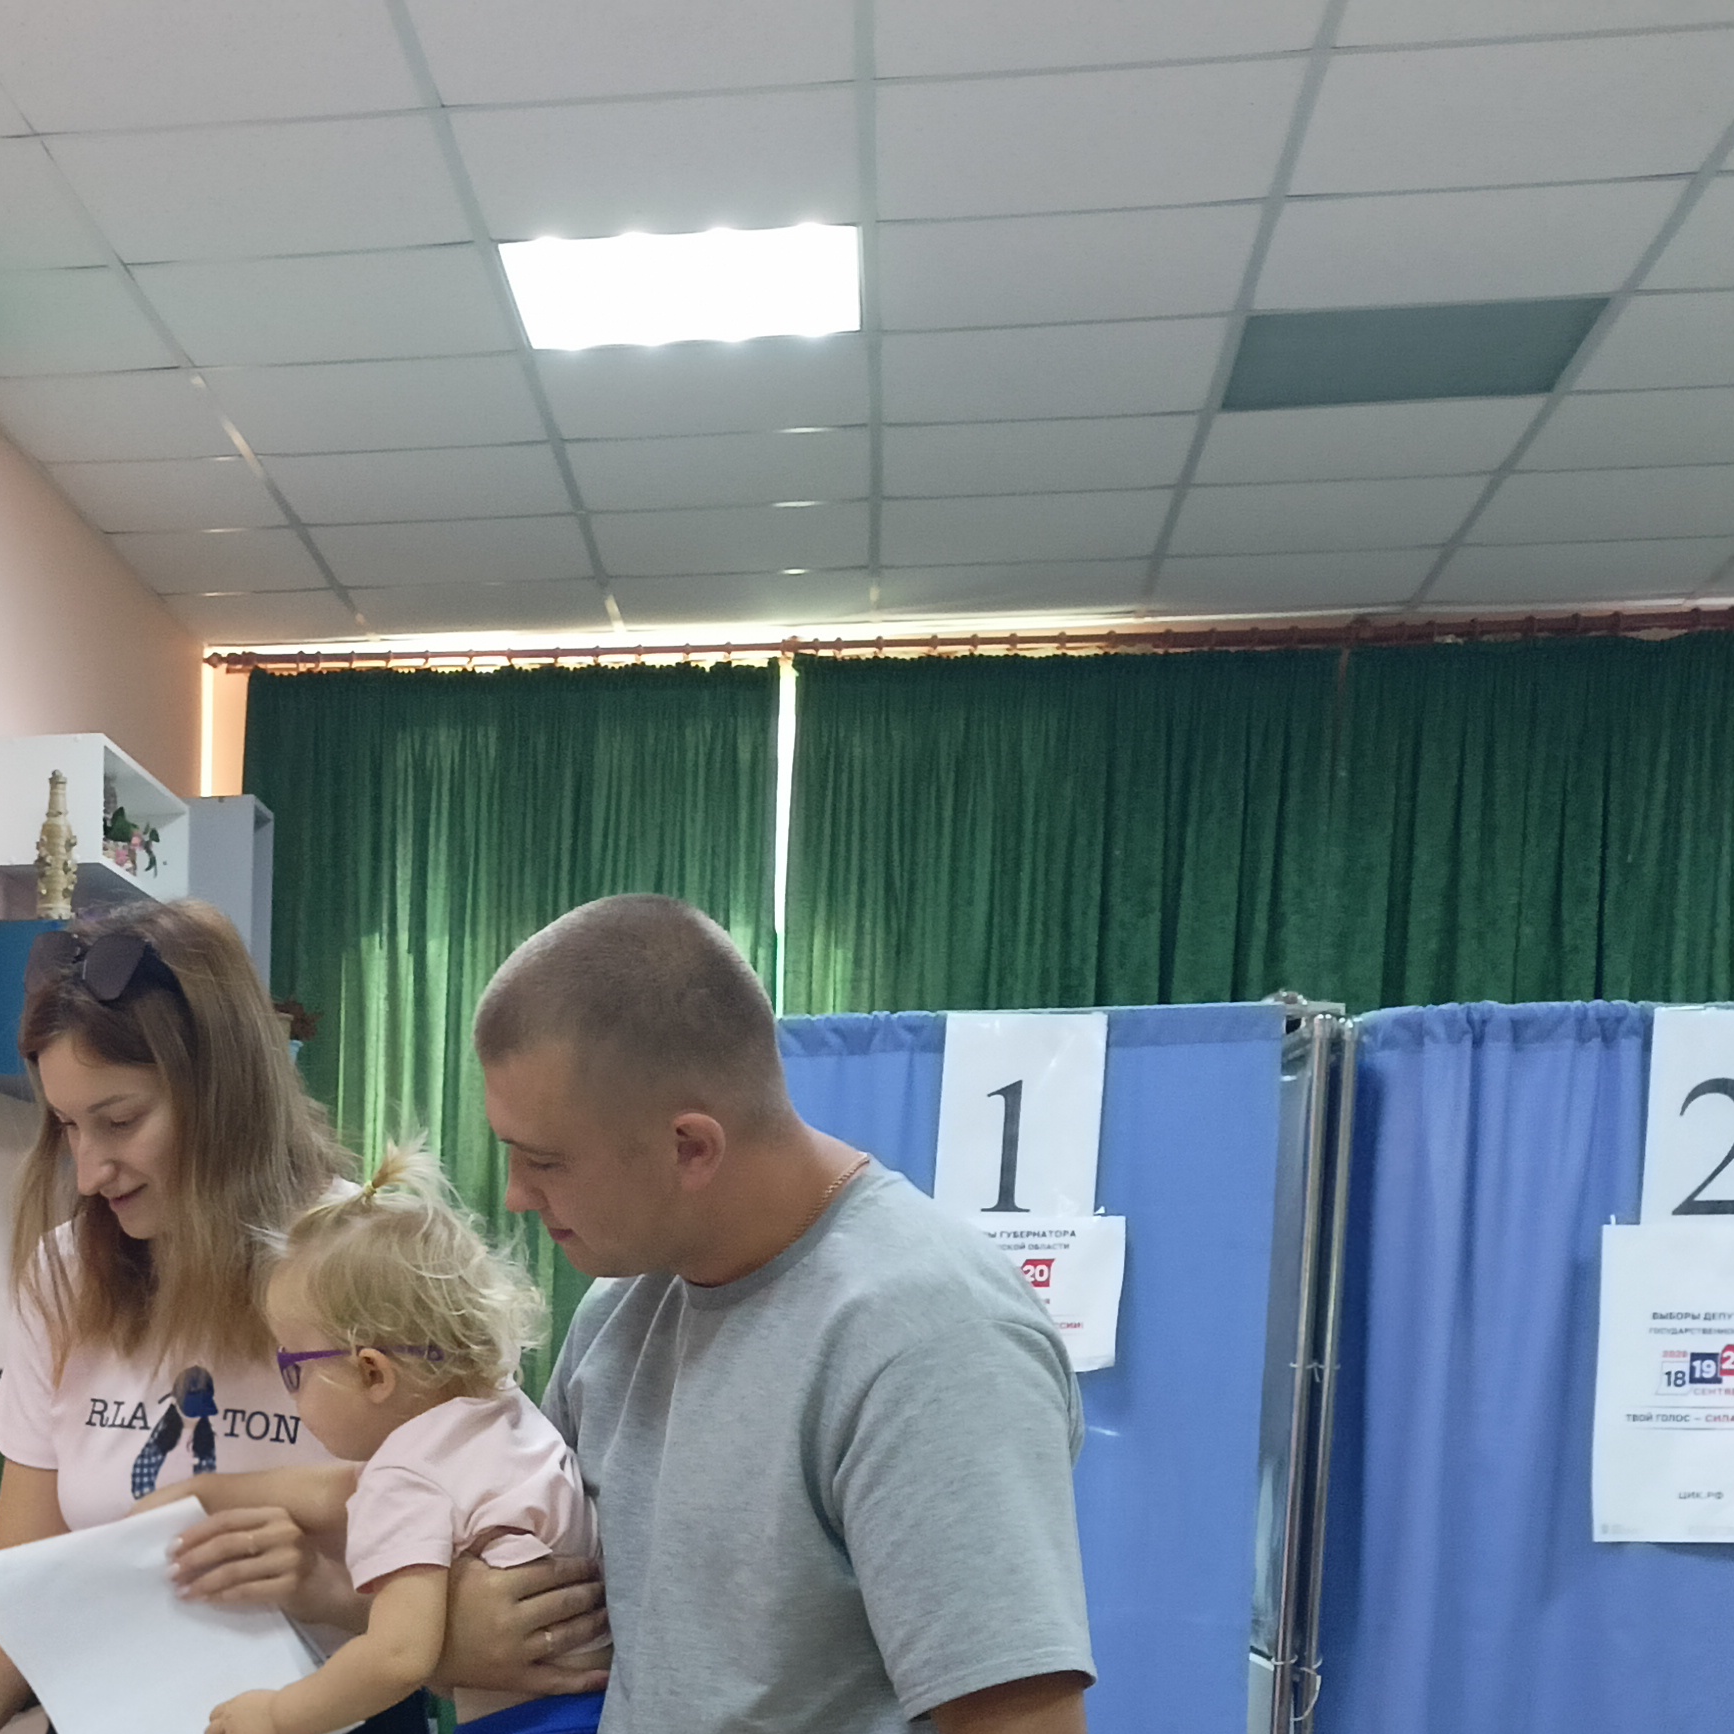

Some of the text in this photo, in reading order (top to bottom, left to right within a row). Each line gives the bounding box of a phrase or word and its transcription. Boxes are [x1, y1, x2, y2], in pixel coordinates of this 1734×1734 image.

[981, 1079, 1030, 1212] 1
[1671, 1077, 1734, 1216] 2
[999, 1230, 1076, 1239] ГУБЕРНАТОРА
[1028, 1243, 1070, 1251] ОБЛАСТИ
[1022, 1264, 1049, 1282] 20
[1652, 1312, 1734, 1321] ВЫБОРЫ ДЕПУ
[1664, 1370, 1686, 1387] 18
[1692, 1359, 1716, 1378] 19
[1626, 1411, 1653, 1422] ТВОЙ
[1656, 1413, 1690, 1422] ГОЛОС
[223, 1408, 301, 1445] TON
